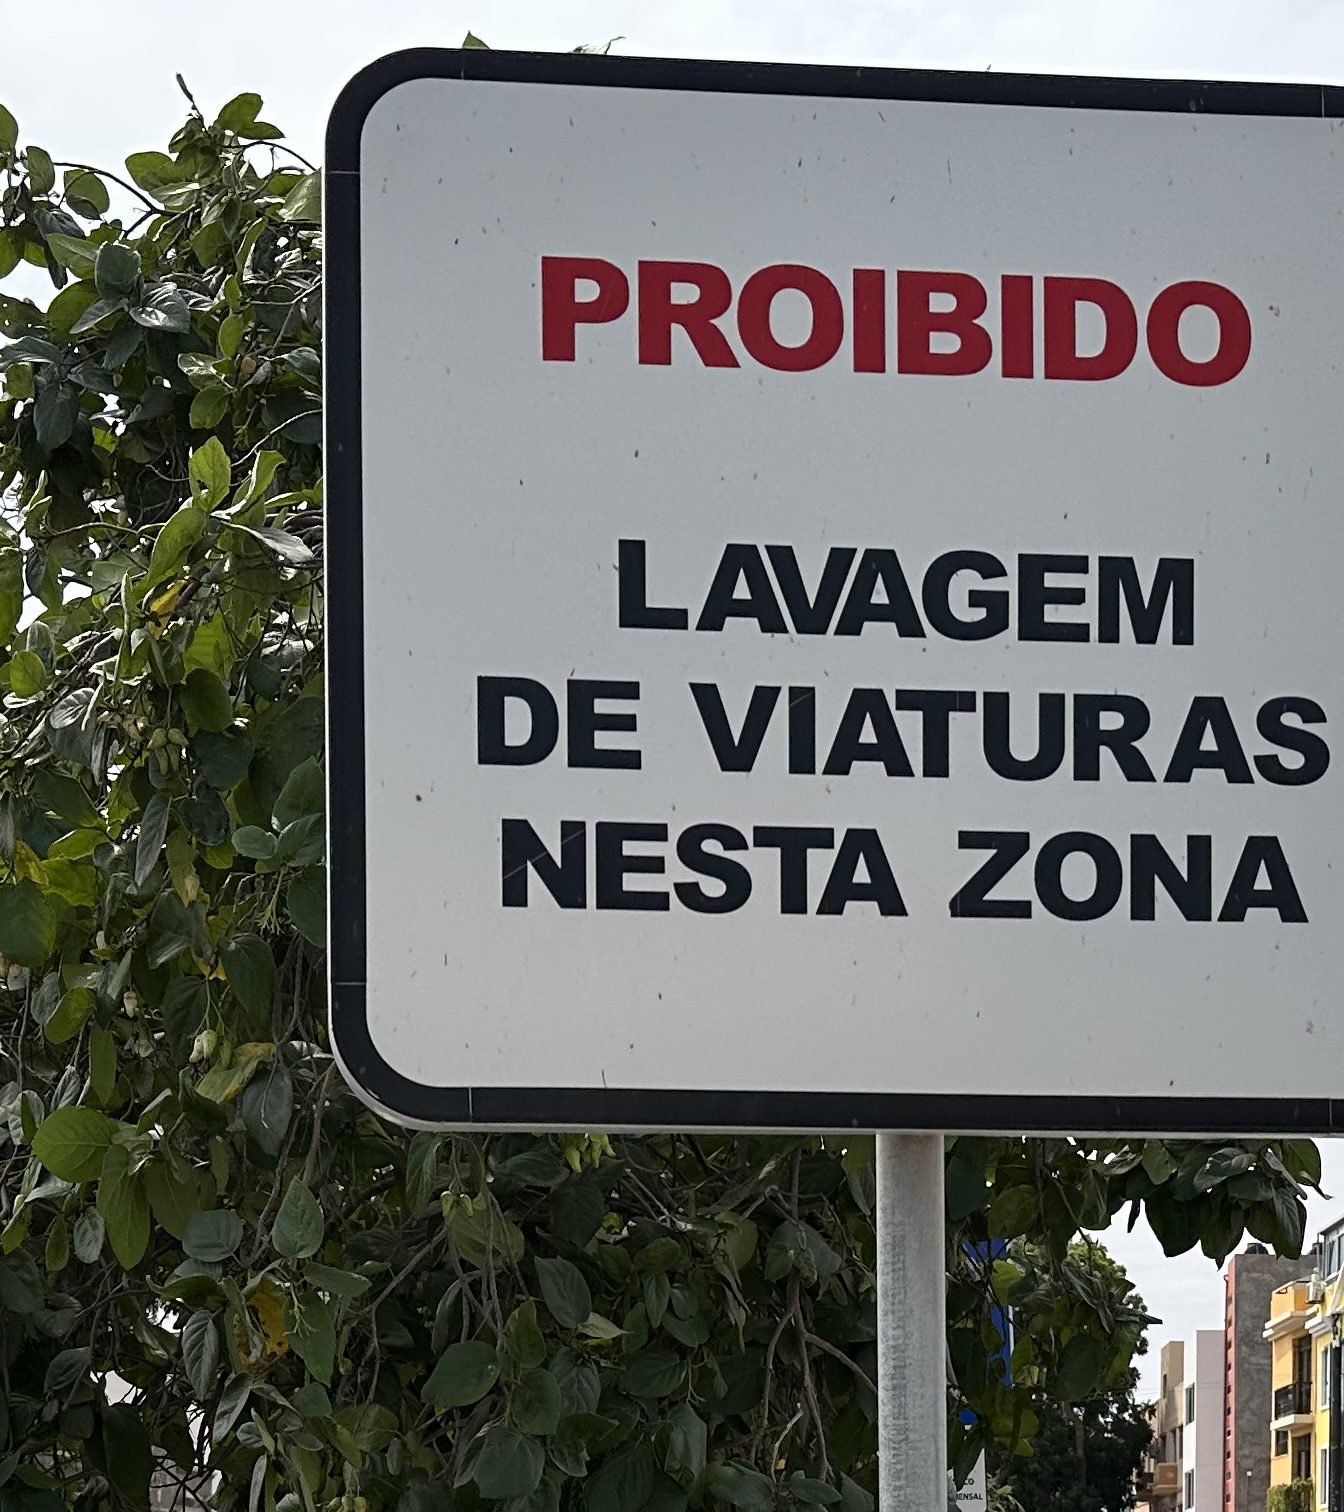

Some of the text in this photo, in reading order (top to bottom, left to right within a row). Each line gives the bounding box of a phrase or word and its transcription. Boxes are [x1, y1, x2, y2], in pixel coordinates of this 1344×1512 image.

[542, 257, 1252, 386] PROIBIDO
[617, 538, 1196, 646] LAVAGEM
[475, 675, 1332, 787] DE VIATURAS
[500, 818, 1310, 924] NESTA ZONA
